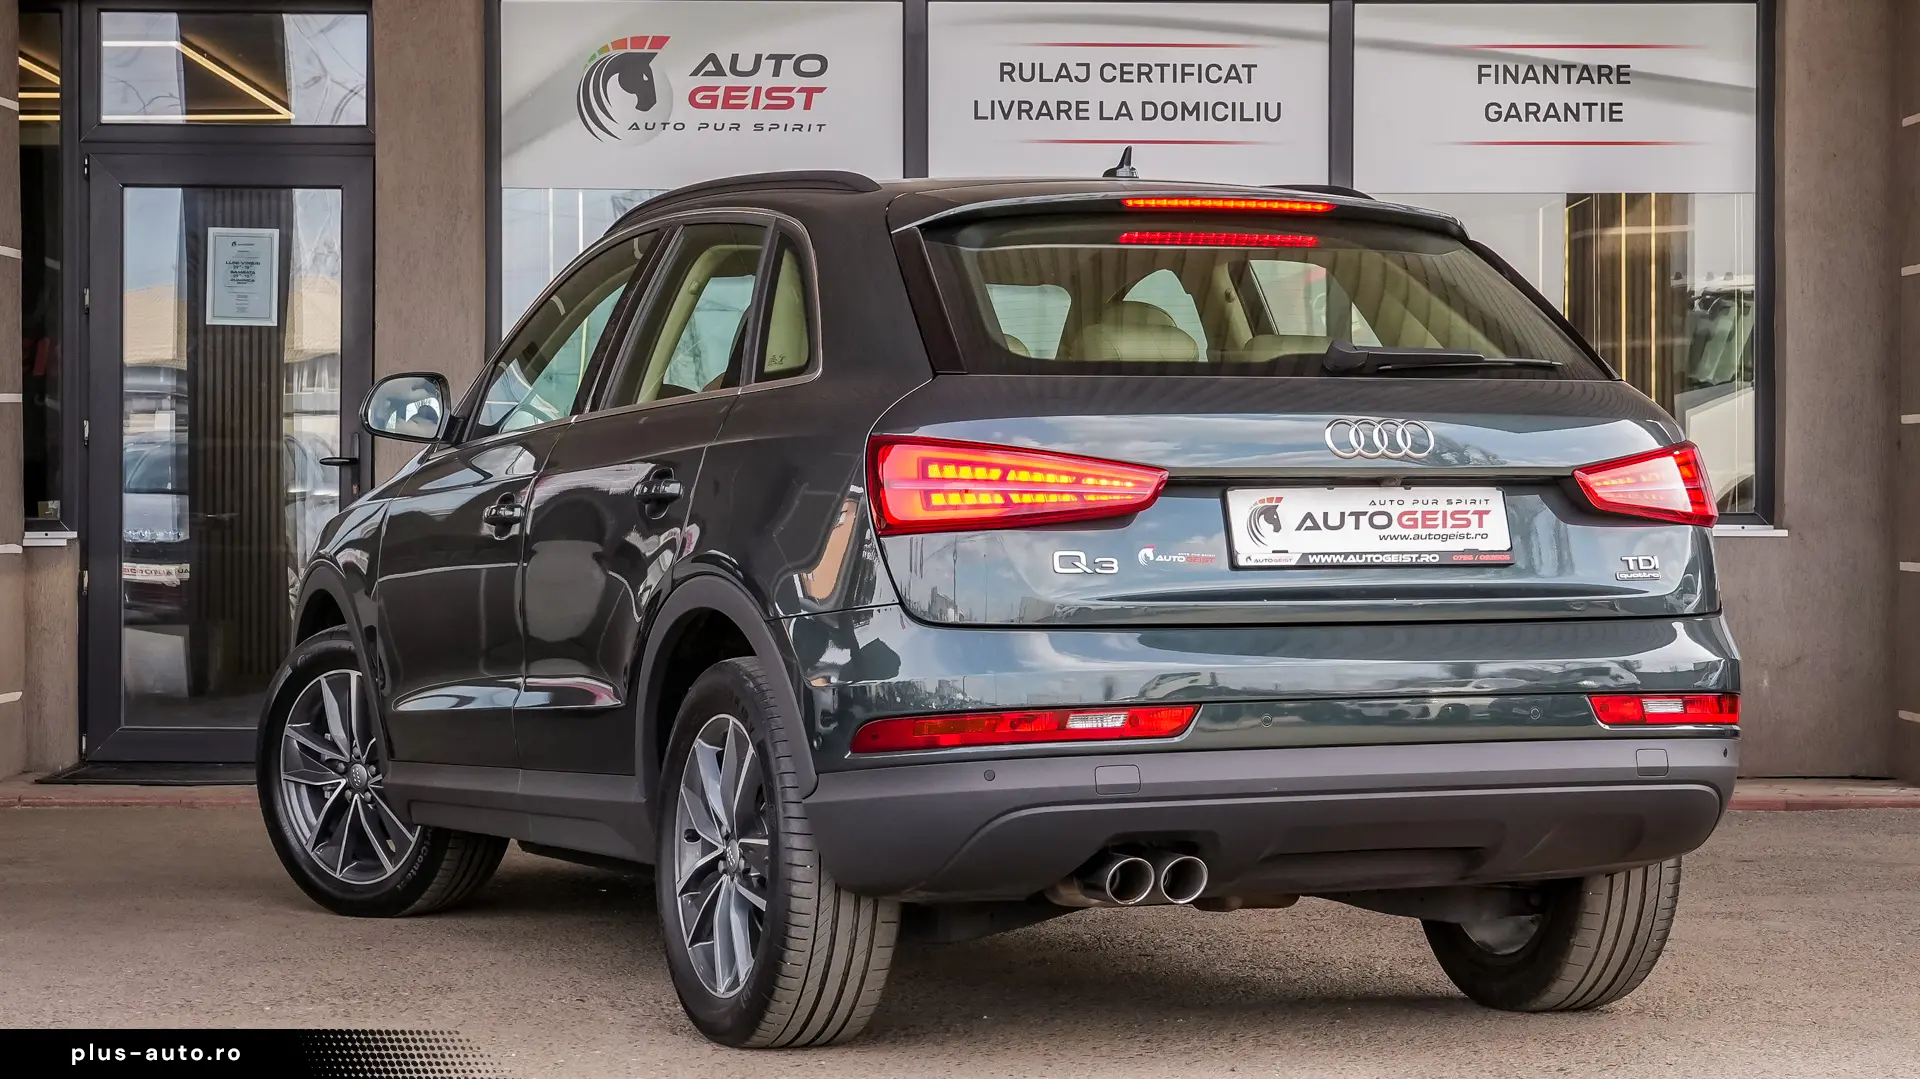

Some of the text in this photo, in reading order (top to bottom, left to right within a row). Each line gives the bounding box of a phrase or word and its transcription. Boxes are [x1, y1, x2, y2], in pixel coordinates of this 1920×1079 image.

[688, 52, 829, 78] AUTO
[999, 62, 1258, 84] RULAJ CERTIFICAT
[1477, 64, 1631, 85] FINANTARE
[687, 85, 828, 111] GEIST
[973, 100, 1282, 123] LIVRARE LA DOMICILIU
[1484, 102, 1624, 123] GARANTIE
[627, 122, 827, 132] AUTO PUR SPIRIT
[1378, 531, 1489, 542] www.autogeist.ro
[1053, 550, 1119, 574] Q3
[1308, 554, 1440, 563] WWW.AUTOGEIST.RO
[1620, 555, 1660, 571] TDI
[1619, 571, 1660, 579] quattro
